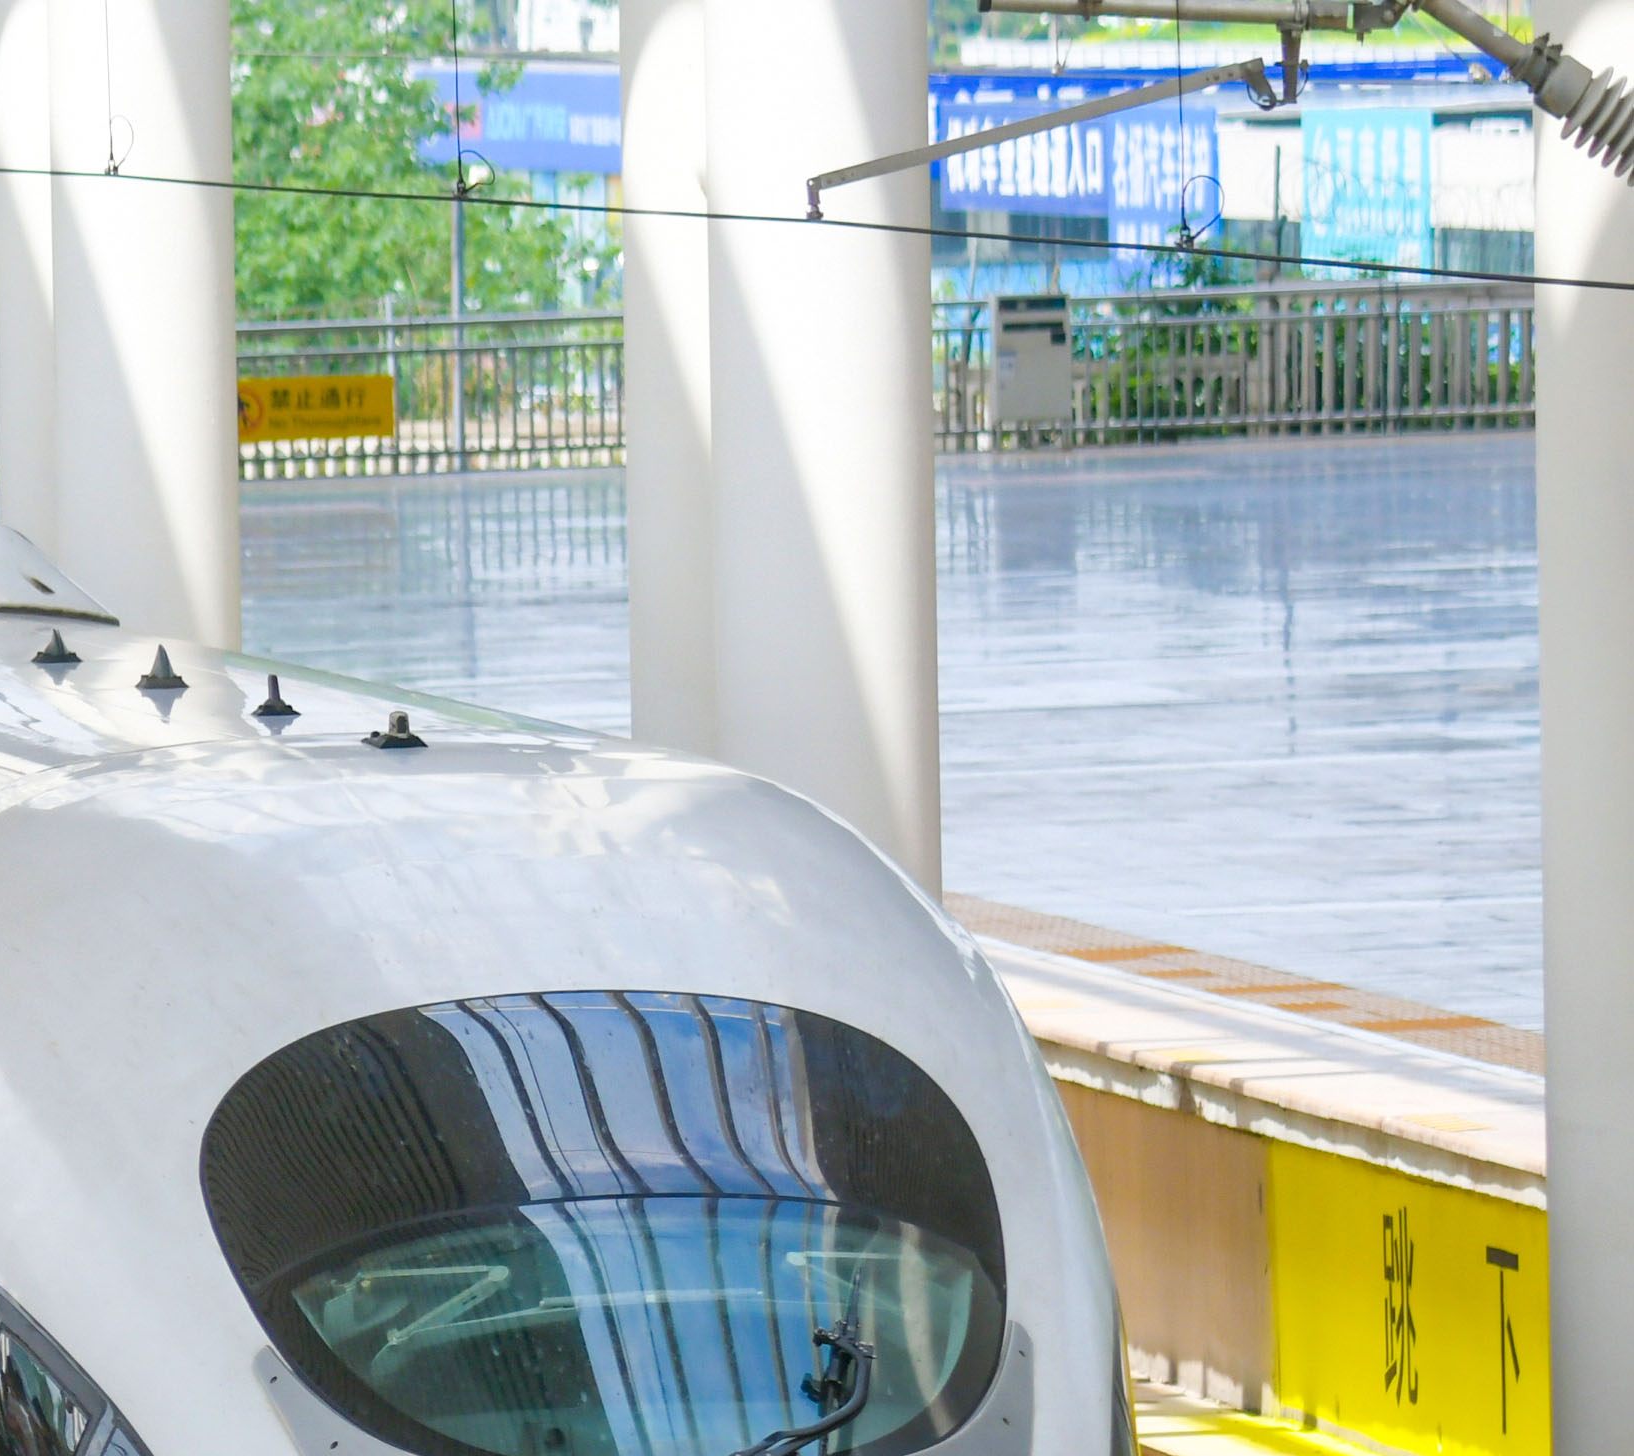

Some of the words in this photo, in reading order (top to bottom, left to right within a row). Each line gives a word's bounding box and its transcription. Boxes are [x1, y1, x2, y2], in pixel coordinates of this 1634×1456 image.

[270, 386, 366, 410] 禁止通行
[1382, 1206, 1521, 1436] 跳下
